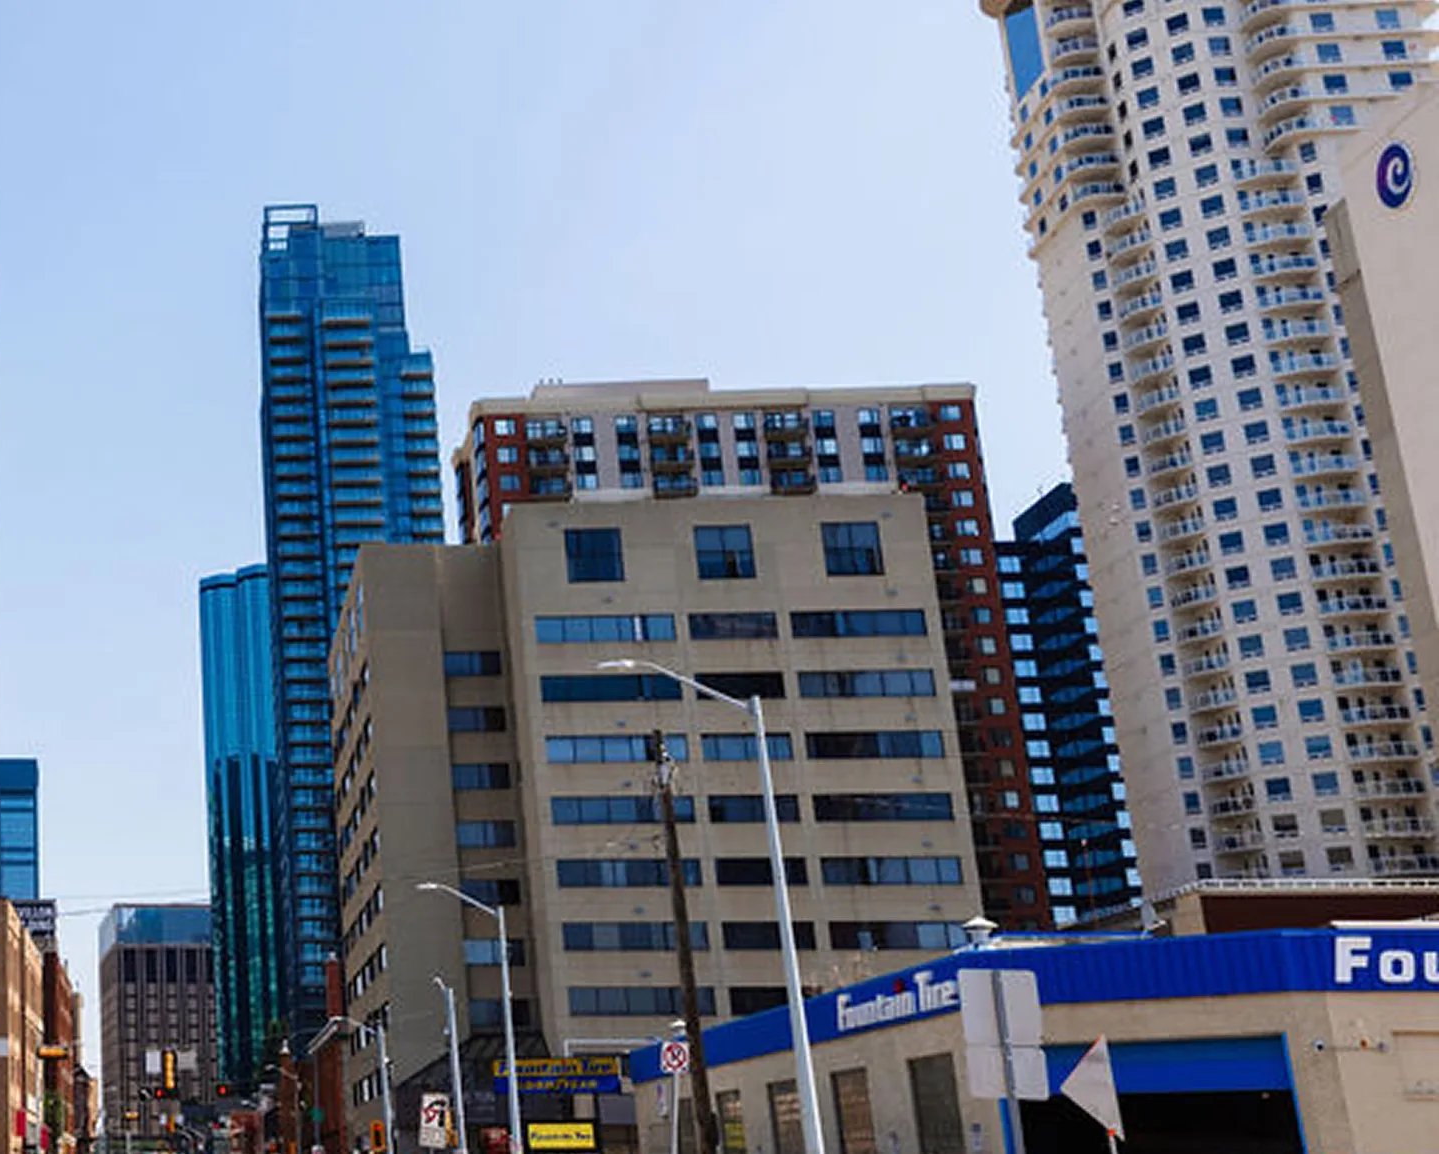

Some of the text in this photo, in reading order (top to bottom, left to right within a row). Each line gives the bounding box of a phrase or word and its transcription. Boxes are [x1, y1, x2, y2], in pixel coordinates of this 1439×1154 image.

[836, 970, 960, 1032] Fountain Tire
[497, 1061, 578, 1076] Funtain
